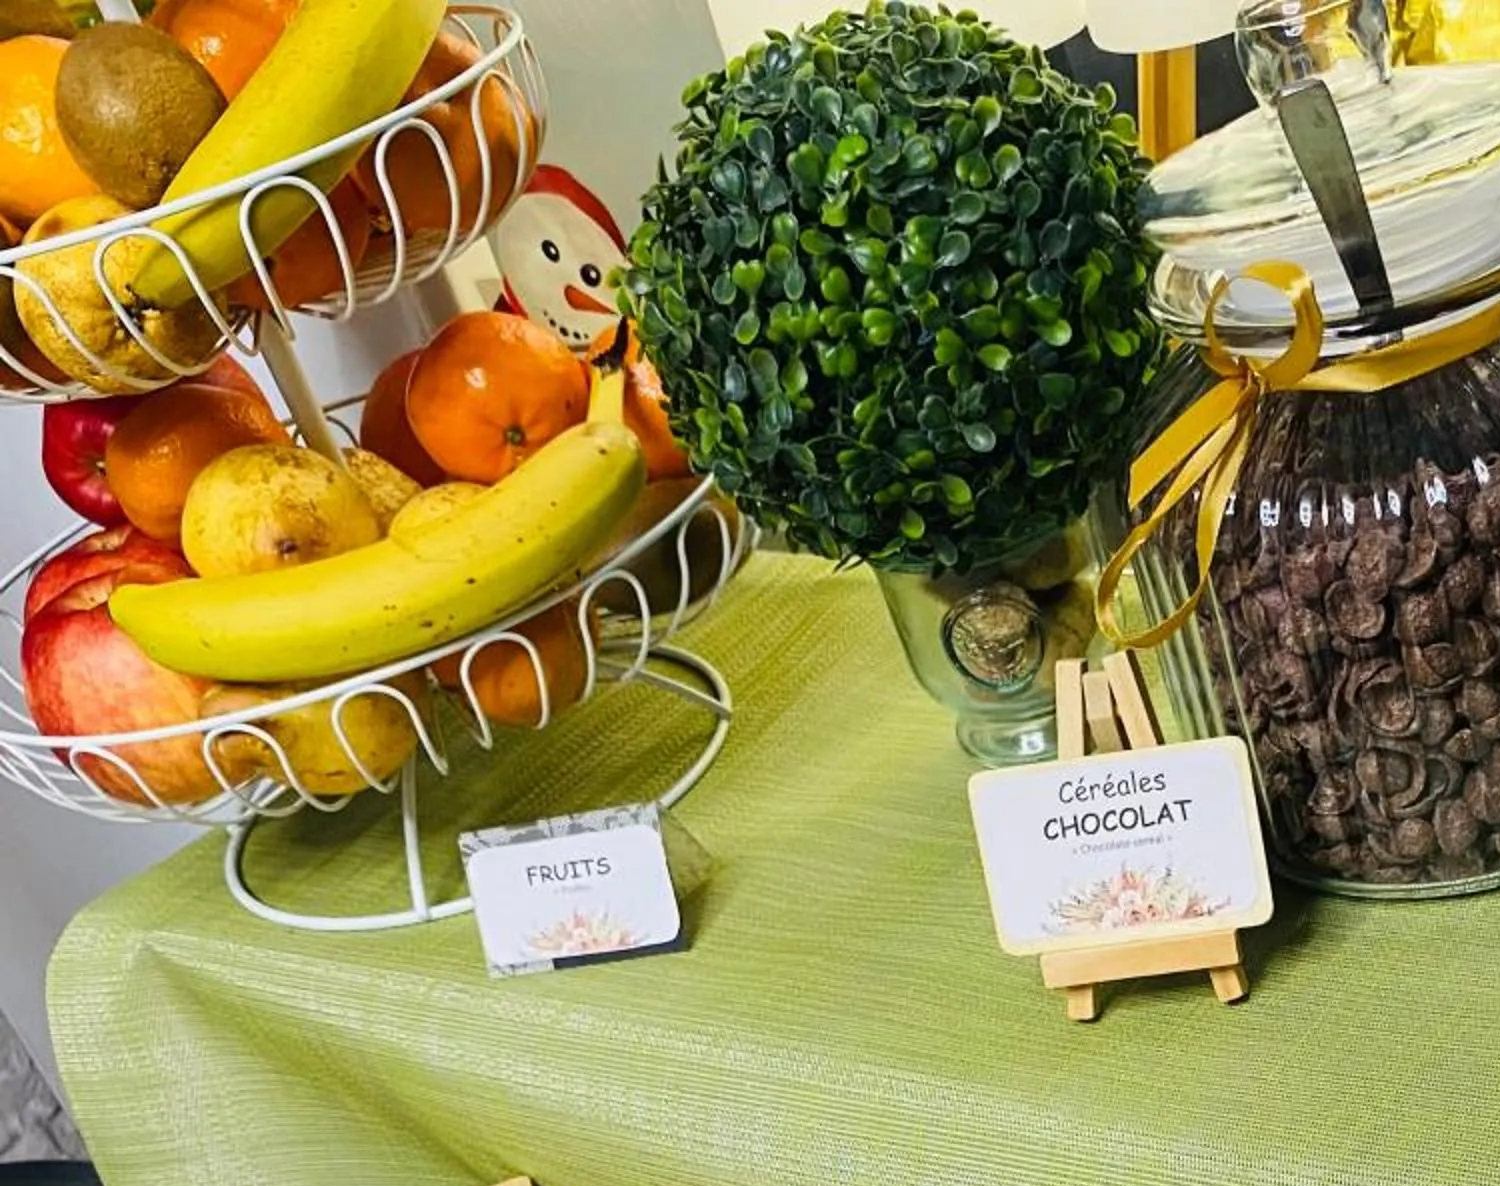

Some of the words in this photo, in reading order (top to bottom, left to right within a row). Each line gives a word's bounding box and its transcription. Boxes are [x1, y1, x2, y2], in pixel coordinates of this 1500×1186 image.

[1058, 769, 1167, 804] Céréales
[1043, 799, 1193, 841] CHOCOLAT
[525, 857, 612, 887] FRUITS
